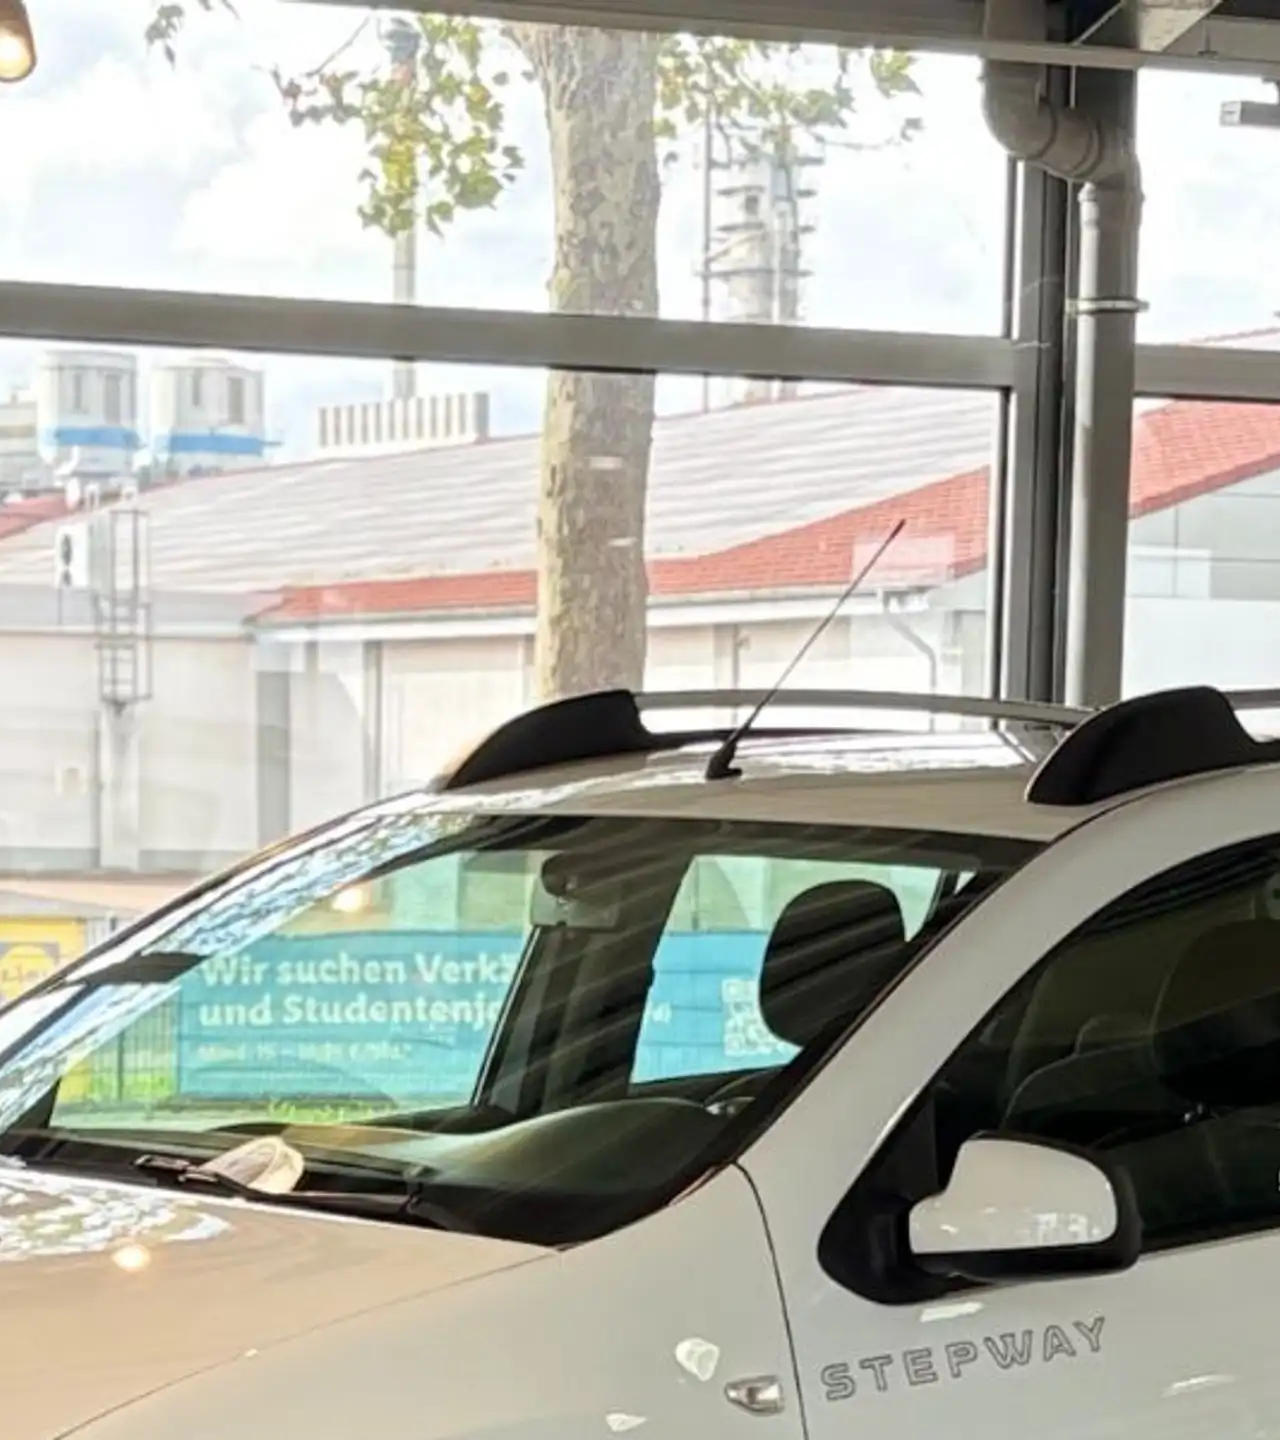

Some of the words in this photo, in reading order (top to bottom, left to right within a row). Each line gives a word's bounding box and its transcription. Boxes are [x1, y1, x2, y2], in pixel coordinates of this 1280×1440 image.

[199, 953, 269, 987] Wir
[276, 951, 407, 985] suchen
[199, 993, 273, 1026] und
[820, 1315, 1106, 1402] STEPWAY
